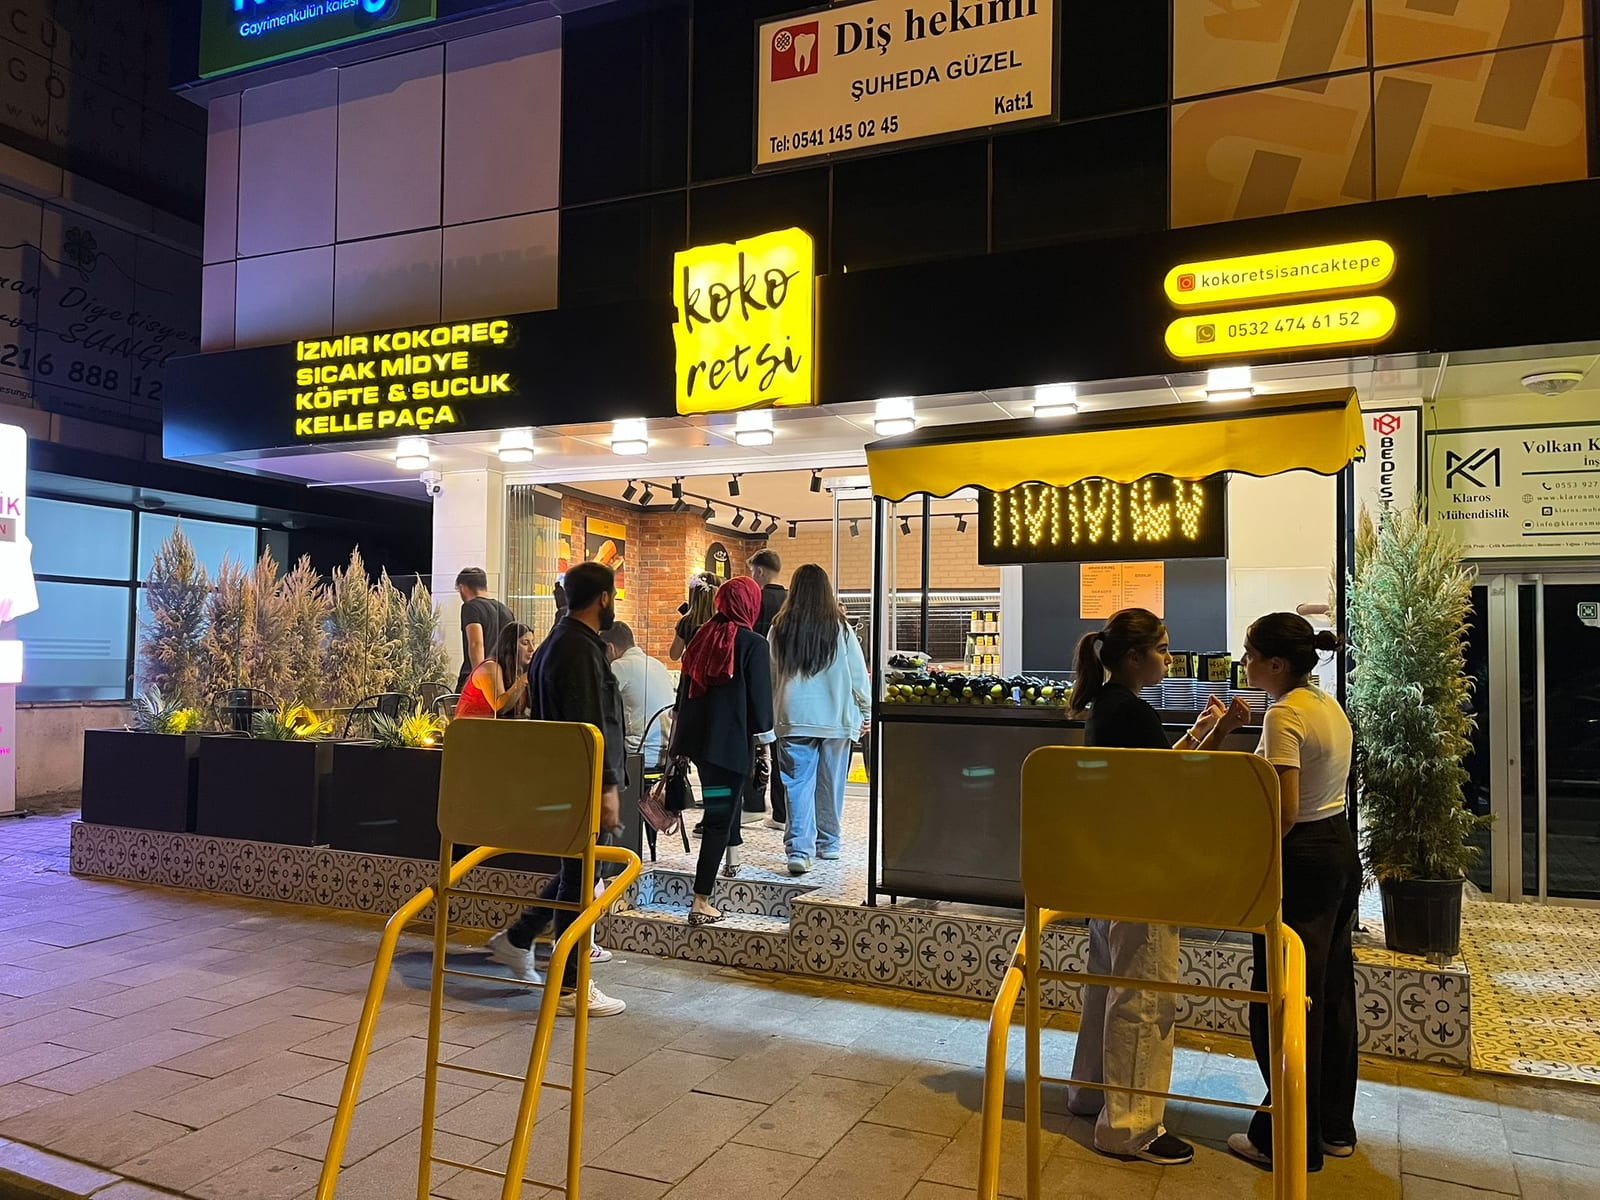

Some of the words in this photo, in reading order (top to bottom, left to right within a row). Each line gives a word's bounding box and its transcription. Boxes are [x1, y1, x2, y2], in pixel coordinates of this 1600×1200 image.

[240, 6, 324, 37] Gayrimenkulün
[834, 17, 892, 56] Diş
[851, 66, 940, 102] ŞUHEDA
[946, 50, 1022, 80] GÜZEL
[994, 91, 1033, 115] Kat:1
[769, 137, 790, 153] Tel:
[792, 129, 824, 149] 0541
[829, 124, 853, 144] 145
[858, 119, 875, 138] 02
[881, 115, 898, 133] 45
[1201, 256, 1381, 288] kokoretsisancaktepe
[683, 252, 800, 334] koko
[297, 335, 368, 361] İZMİR
[373, 320, 509, 353] KOKOREÇ
[1228, 321, 1269, 338] 0532
[1274, 317, 1306, 333] 474
[1312, 314, 1330, 329] 61
[1339, 311, 1360, 326] 52
[0, 343, 55, 376] 216
[68, 360, 119, 391] 888
[296, 361, 375, 386] SICAK
[381, 351, 469, 377] MİDYE
[687, 336, 802, 398] retsi
[296, 386, 379, 411] KÖFTE
[387, 384, 407, 403] &
[412, 373, 510, 399] SUCUK
[295, 411, 374, 436] KELLE
[378, 405, 455, 430] PAÇA
[1522, 440, 1582, 455] Volkan
[1437, 508, 1510, 521] Mühendislik
[1452, 492, 1491, 504] Klaros
